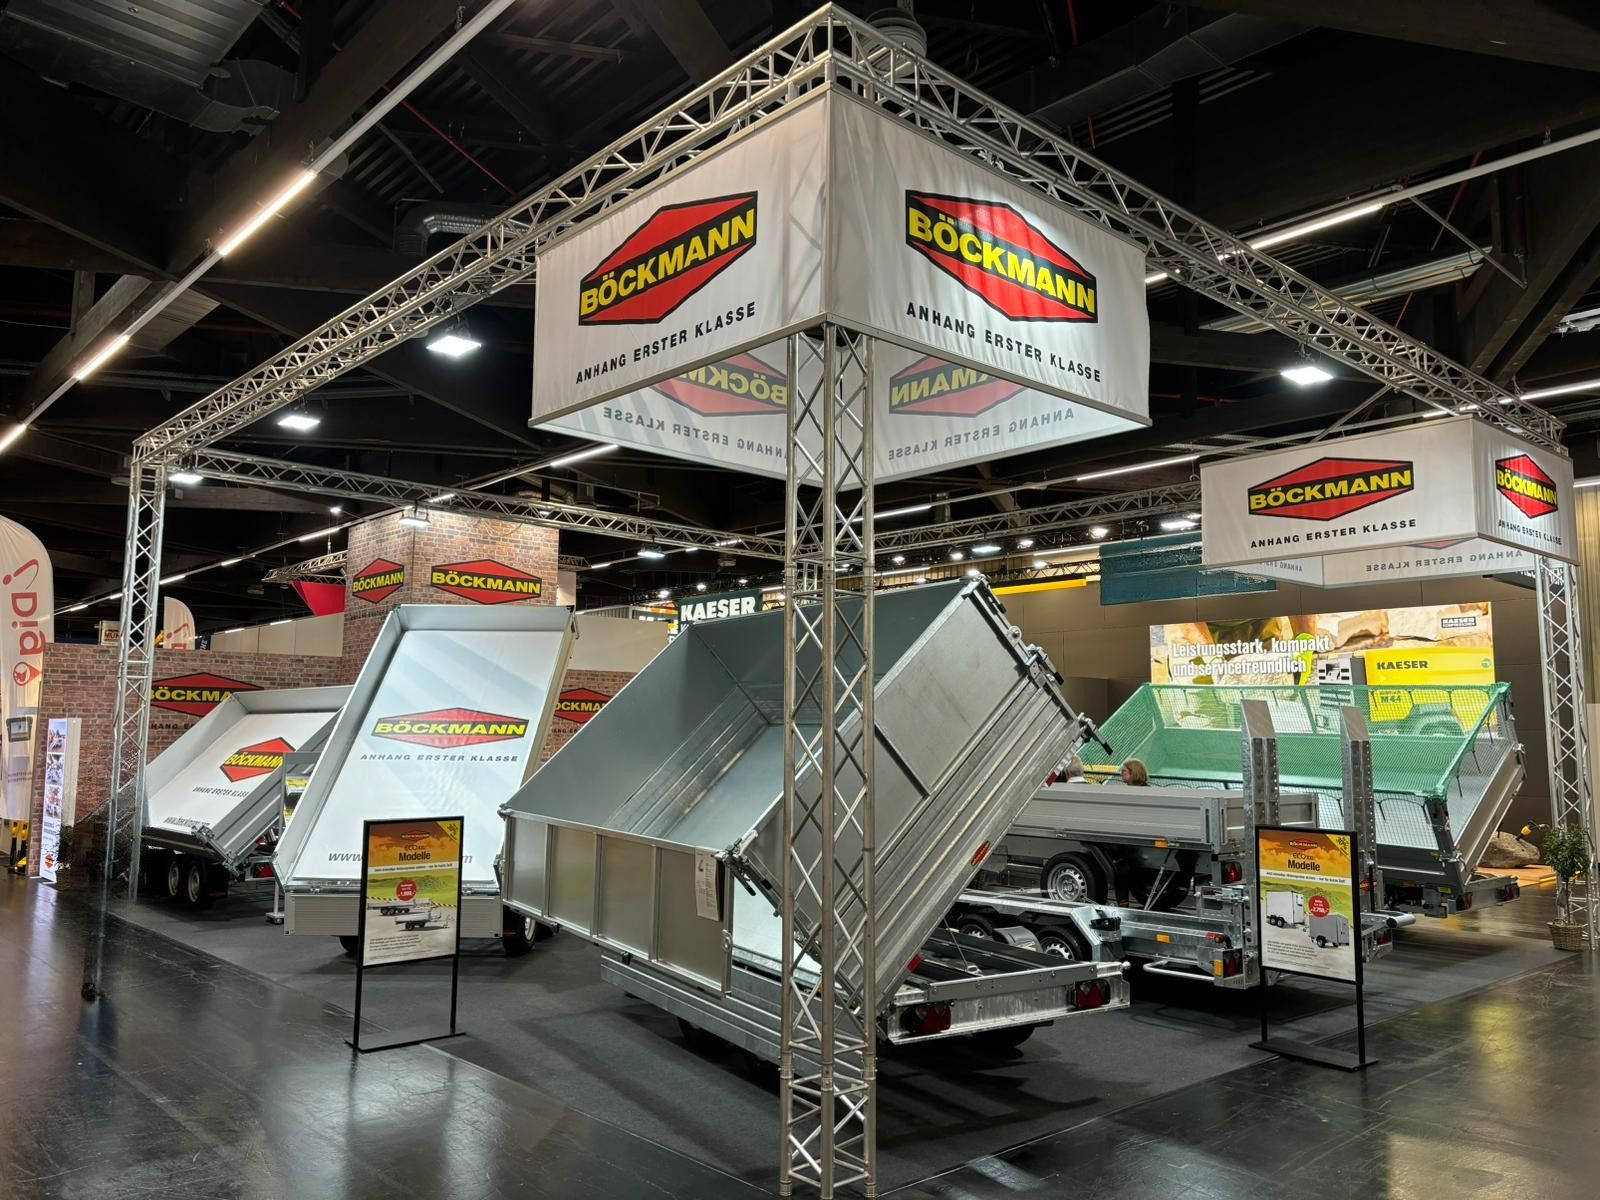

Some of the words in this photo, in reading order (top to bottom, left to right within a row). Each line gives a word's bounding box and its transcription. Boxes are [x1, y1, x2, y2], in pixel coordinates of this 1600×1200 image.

[580, 208, 755, 316] BÖCKMANN
[909, 207, 1095, 314] BÖCKMANN
[576, 353, 627, 384] ANHANG
[633, 329, 688, 362] ERSTER
[694, 301, 756, 338] KLASSE
[906, 301, 976, 339] ANHANG
[985, 329, 1042, 362] ERSTER
[1050, 352, 1101, 383] KLASSE
[1250, 469, 1412, 510] BÖCKMANN
[1496, 468, 1558, 506] BÖCKMANN
[1250, 534, 1300, 549] ANHANG
[1306, 526, 1357, 541] ERSTER
[1362, 518, 1417, 534] KLASSE
[352, 571, 404, 593] BÖCKMANN
[432, 570, 541, 594] BÖCKMANN
[680, 596, 756, 622] KAESER
[1173, 638, 1267, 658] Leistungsstark,
[1272, 635, 1330, 654] kompakt
[1173, 662, 1195, 677] und
[1199, 657, 1308, 676] servicefreundlich
[1376, 660, 1429, 670] KAESER
[150, 686, 232, 702] ÖCKMA
[374, 720, 526, 735] BÖCKMANN
[360, 753, 411, 761] ANHANG
[416, 754, 465, 762] ERSTER
[470, 755, 519, 763] KLASSE
[1287, 859, 1321, 872] Modelle
